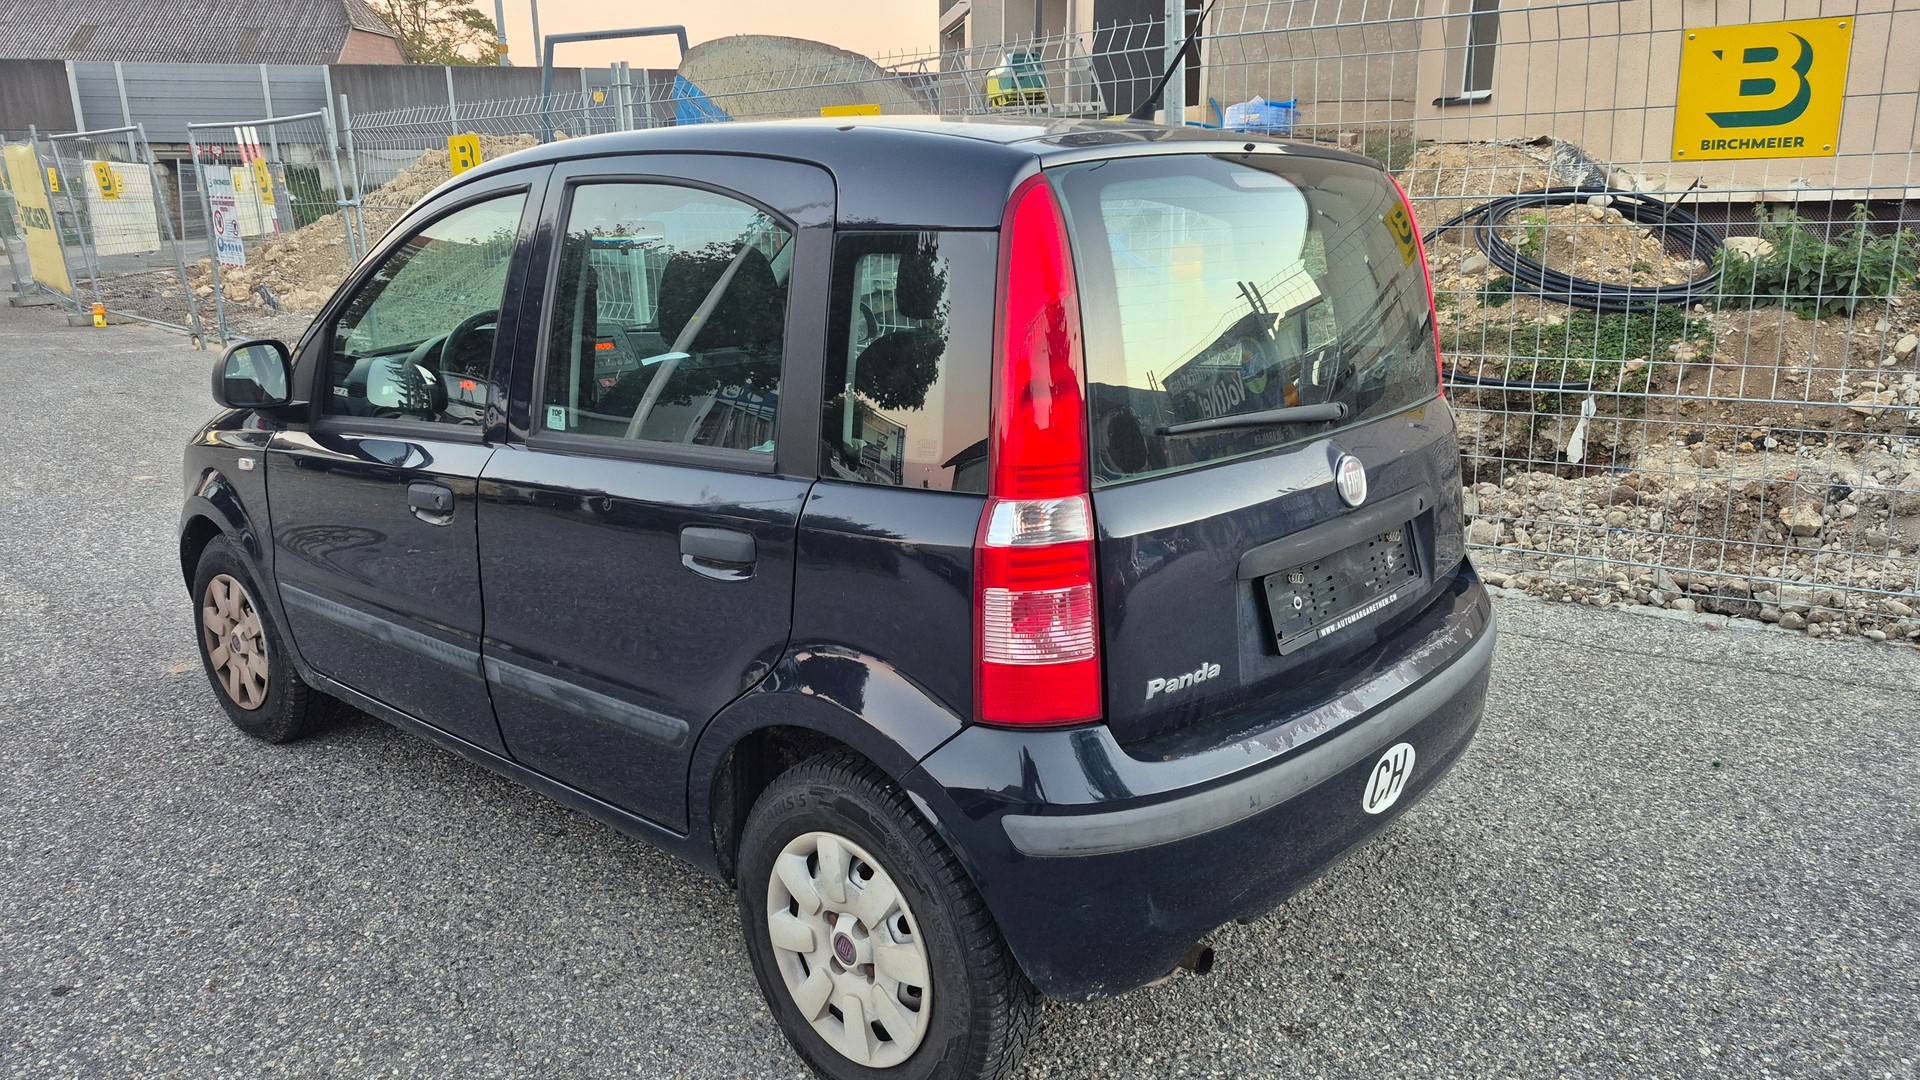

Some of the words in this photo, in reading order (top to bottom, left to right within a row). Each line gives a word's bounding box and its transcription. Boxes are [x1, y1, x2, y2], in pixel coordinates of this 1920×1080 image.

[1705, 31, 1814, 128] B
[453, 140, 476, 170] B
[1700, 136, 1805, 151] BIRCHMEIER
[1145, 662, 1221, 699] Panda
[1369, 748, 1407, 809] CH
